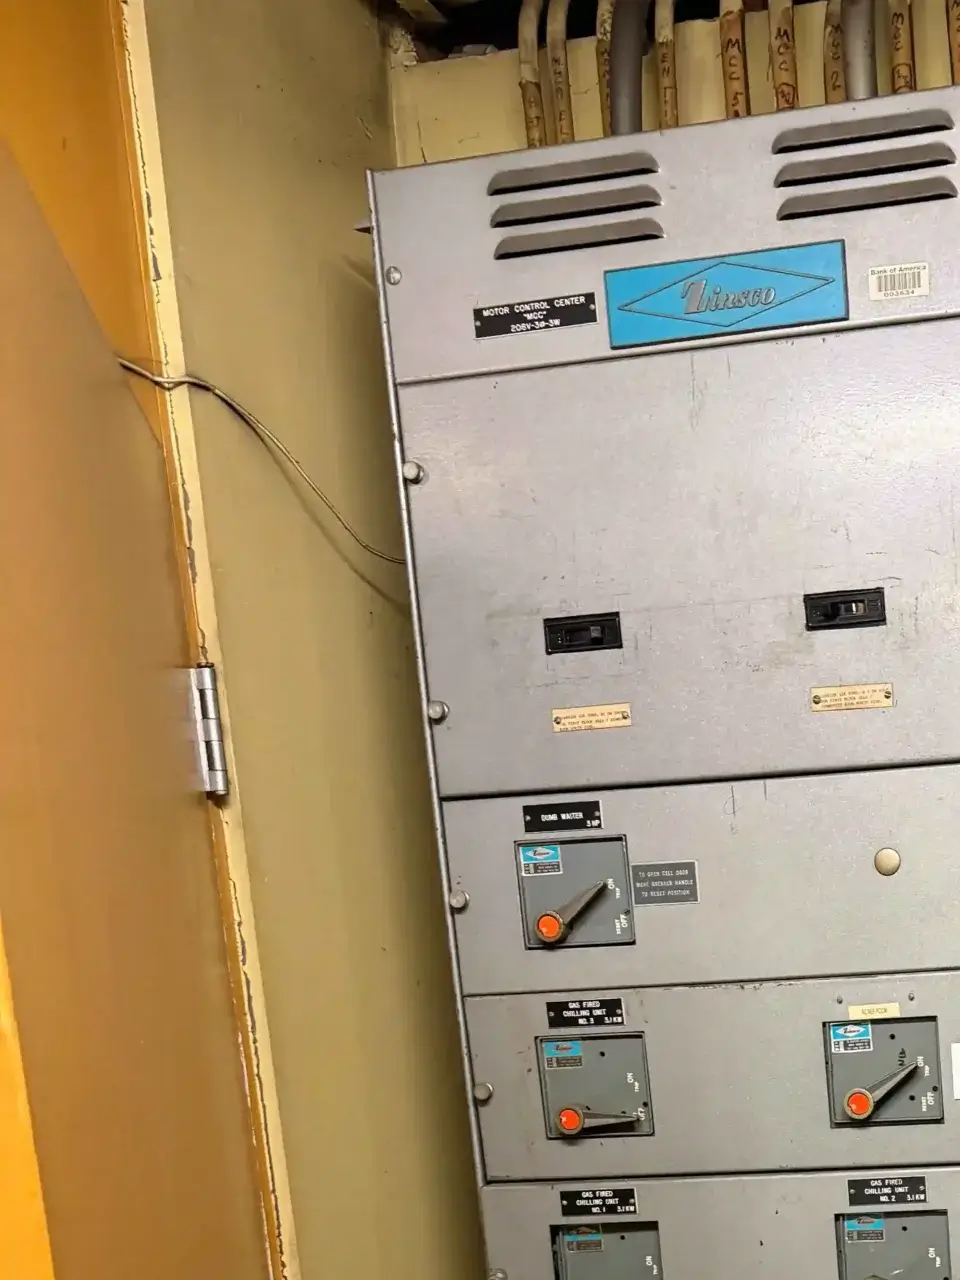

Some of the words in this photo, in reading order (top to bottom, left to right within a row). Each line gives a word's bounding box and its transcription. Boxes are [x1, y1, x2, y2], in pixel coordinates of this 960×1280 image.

[870, 268, 888, 276] Bank
[898, 264, 927, 272] America
[680, 278, 776, 315] Zinsco
[482, 307, 510, 317] MOTOR
[514, 301, 551, 314] CONTROL
[554, 296, 586, 307] CENTER
[607, 878, 614, 889] ON
[620, 914, 628, 928] OFF
[582, 1000, 600, 1008] FIRED
[916, 1055, 924, 1067] ON
[626, 1072, 634, 1083] ON
[927, 1091, 935, 1105] OFF
[864, 1187, 892, 1195] CHILLING
[928, 1247, 936, 1258] ON
[645, 1255, 653, 1266] ON
